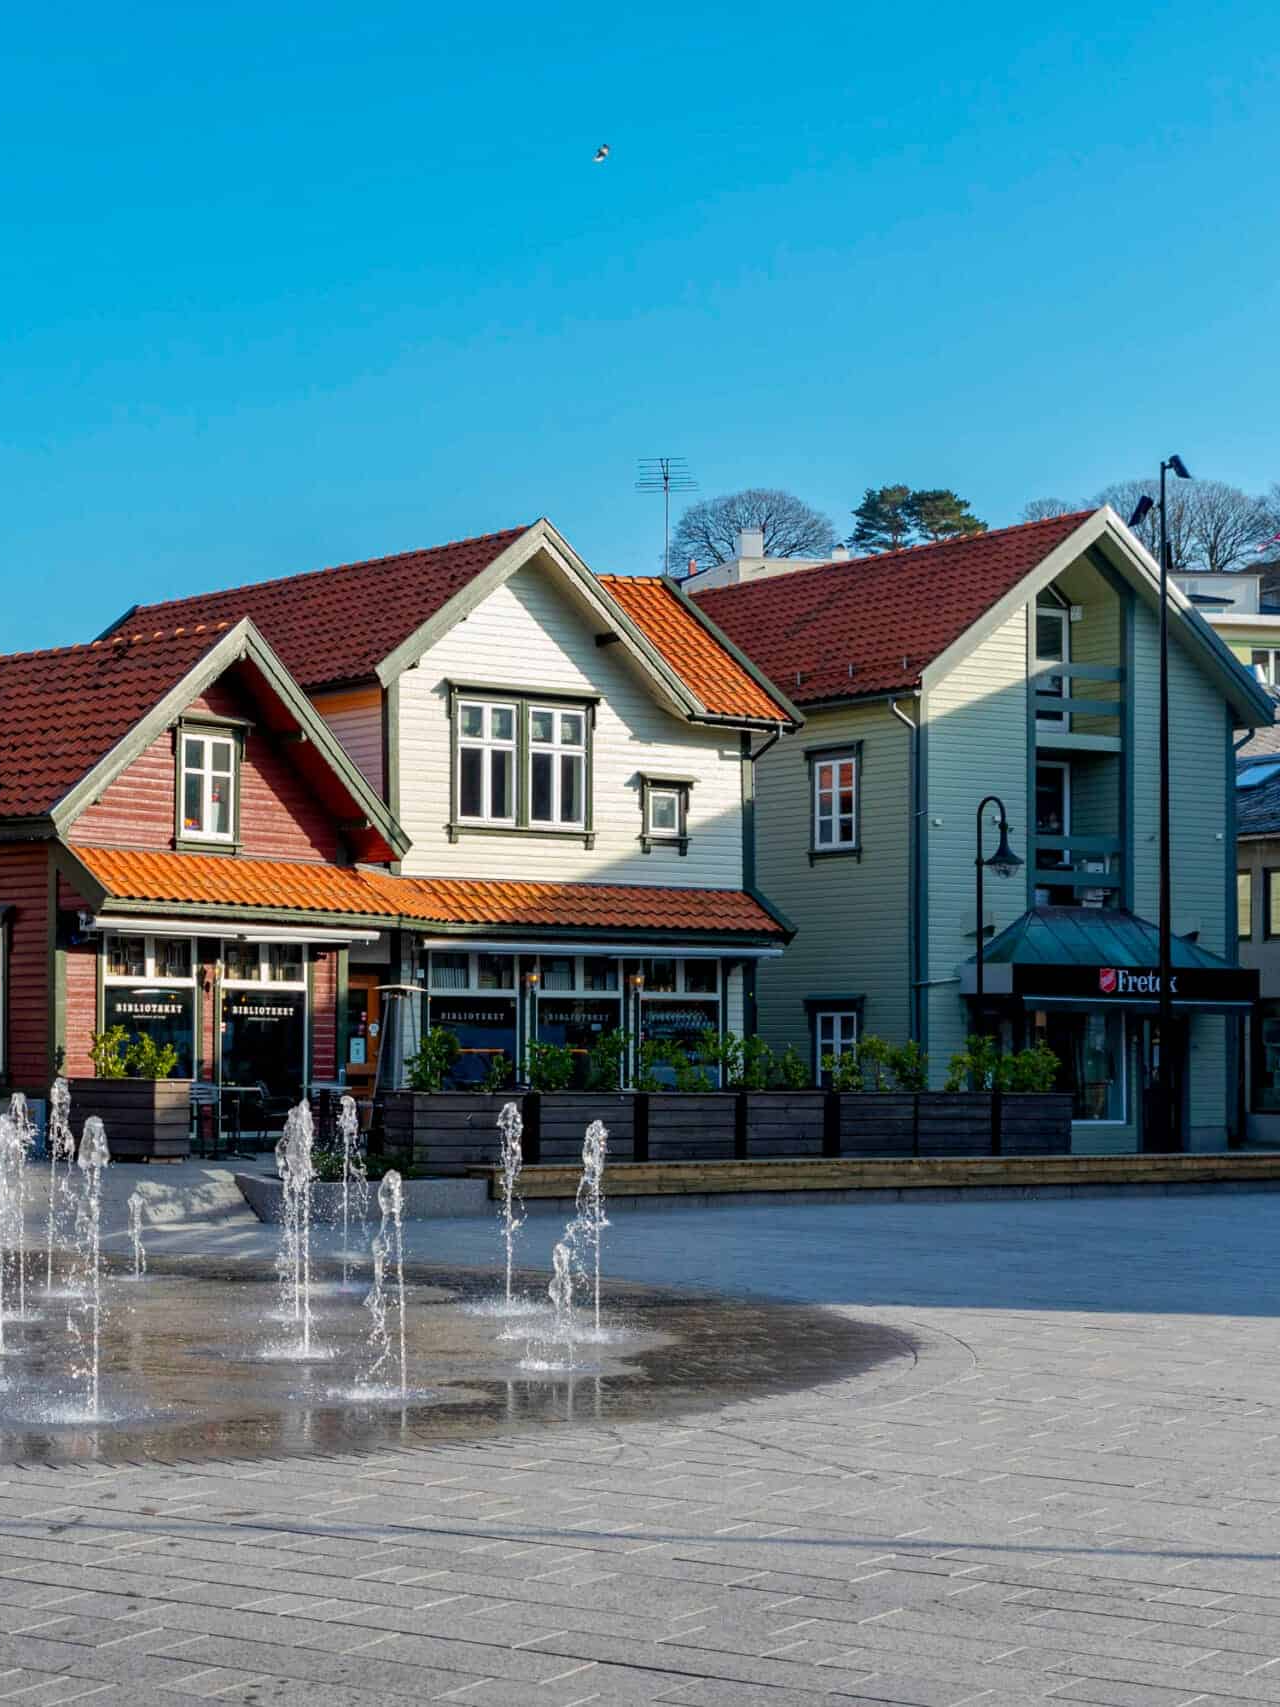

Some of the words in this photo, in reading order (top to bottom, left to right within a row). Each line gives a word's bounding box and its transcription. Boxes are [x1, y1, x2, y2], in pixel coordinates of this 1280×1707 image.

[115, 1003, 183, 1014] BIBLIOTEKET
[232, 1005, 295, 1016] BIBLIOTEKET
[440, 1012, 505, 1021] BIBLIOTEKET
